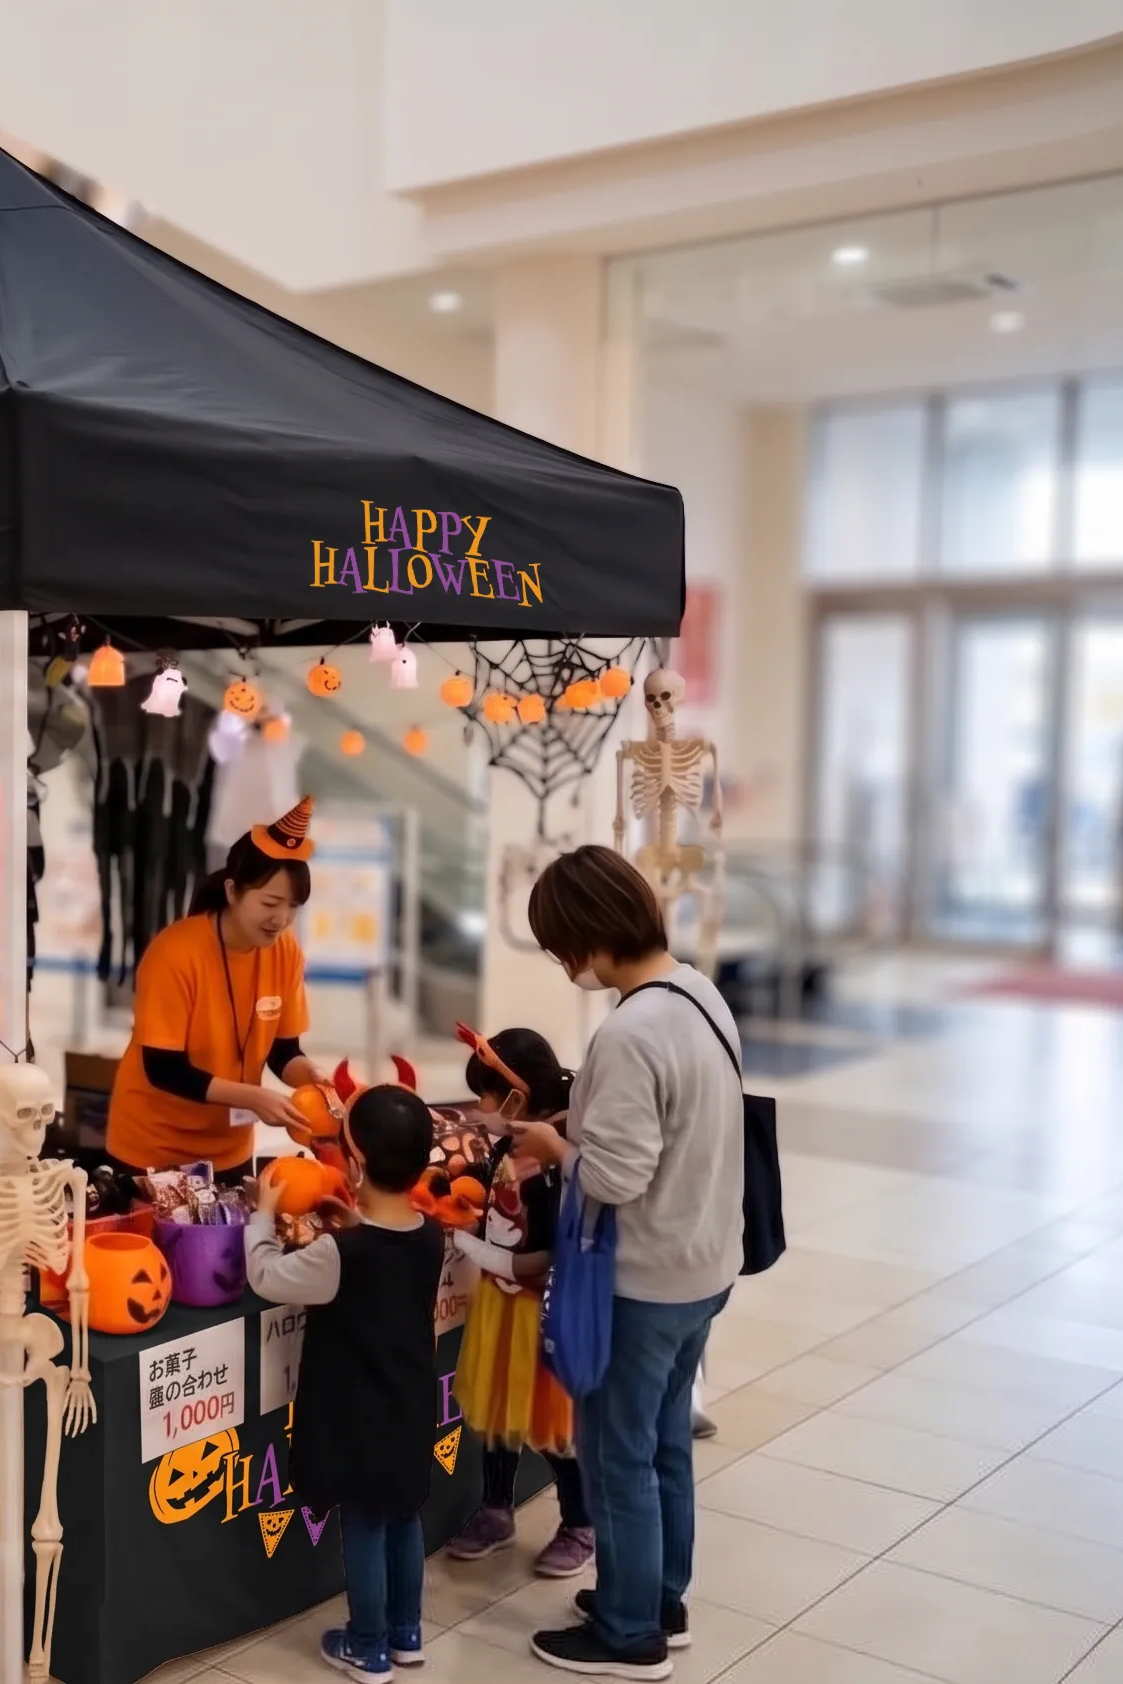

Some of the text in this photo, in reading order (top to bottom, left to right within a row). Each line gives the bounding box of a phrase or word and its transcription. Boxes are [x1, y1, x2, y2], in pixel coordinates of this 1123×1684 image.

[360, 499, 492, 557] HAPPY
[310, 539, 544, 607] HALLOWEEN
[149, 1347, 198, 1383] お菓子
[163, 1391, 235, 1439] 1,000円
